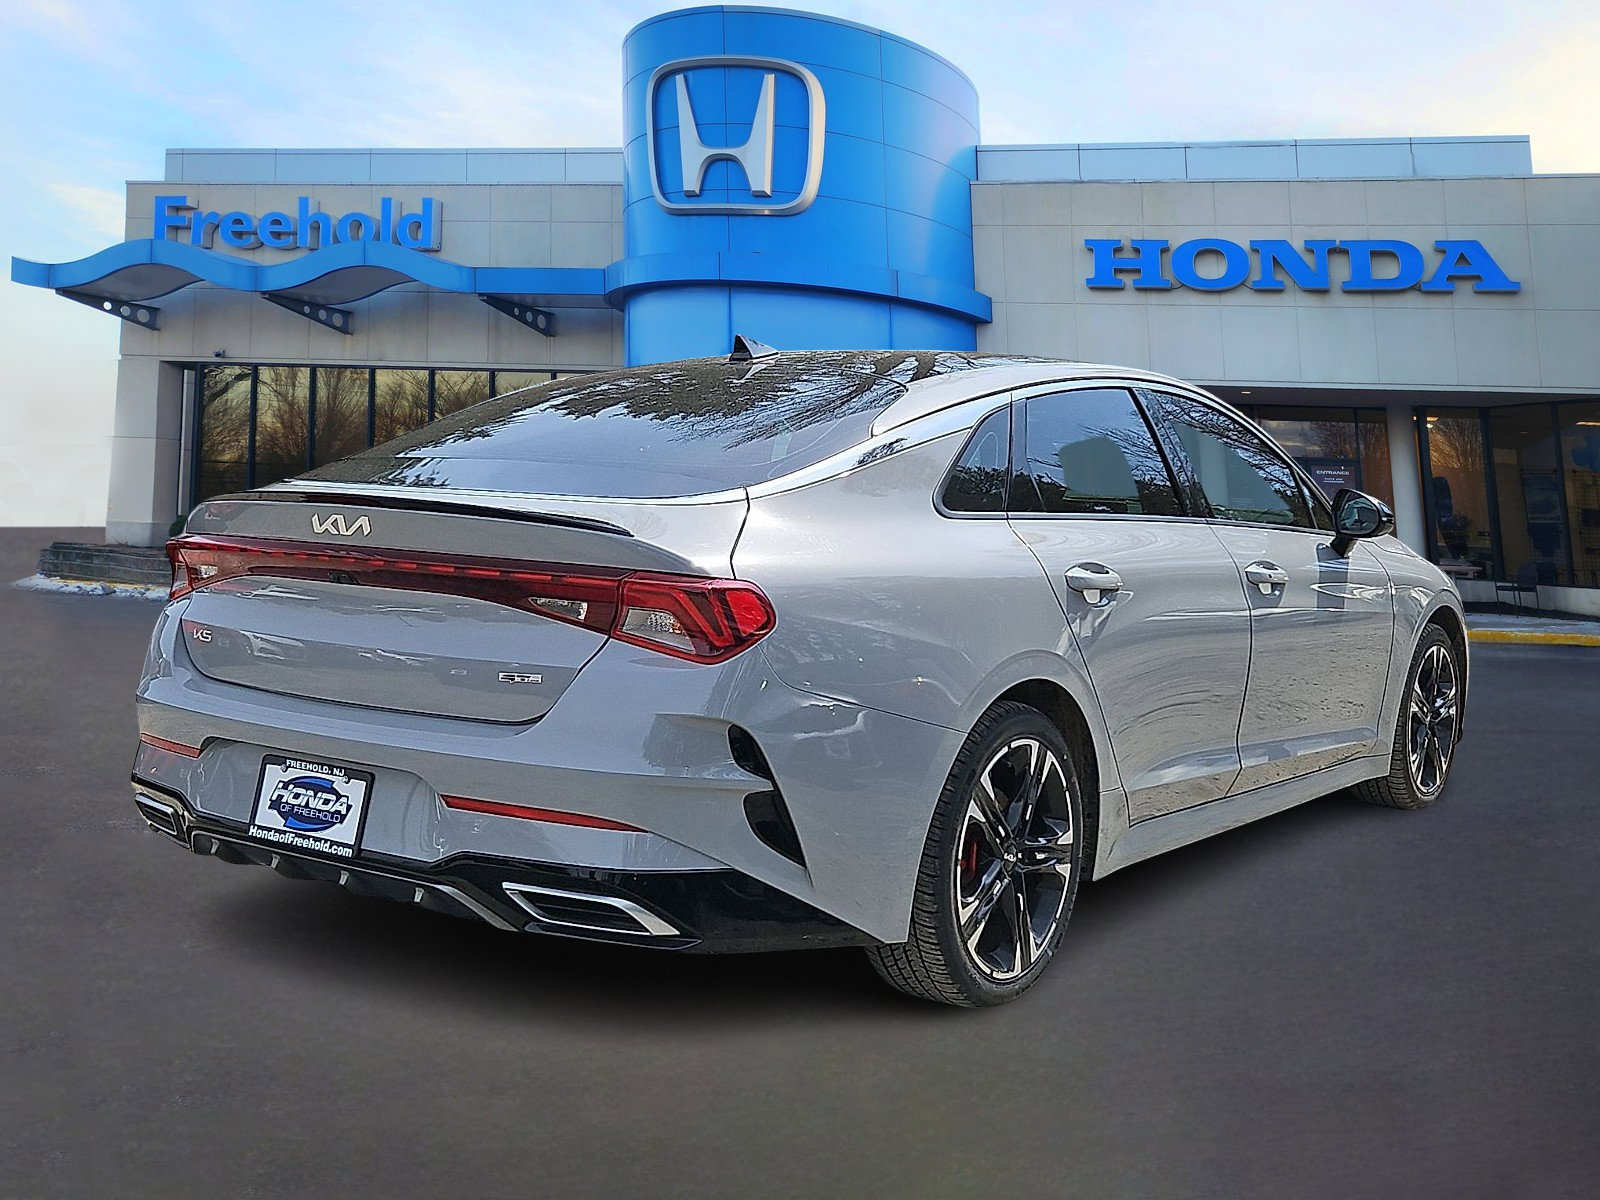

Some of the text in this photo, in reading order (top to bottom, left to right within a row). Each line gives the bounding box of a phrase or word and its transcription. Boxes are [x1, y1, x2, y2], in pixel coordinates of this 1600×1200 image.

[153, 195, 442, 250] Freehold
[1084, 238, 1521, 292] HONDA
[311, 513, 372, 537] KIA
[193, 627, 212, 643] K5
[286, 759, 345, 777] FREEHOLD, NJ
[271, 782, 348, 814] HONDA
[280, 803, 341, 822] OF FREEHOLD
[248, 825, 353, 857] HondaofFreehold.com
